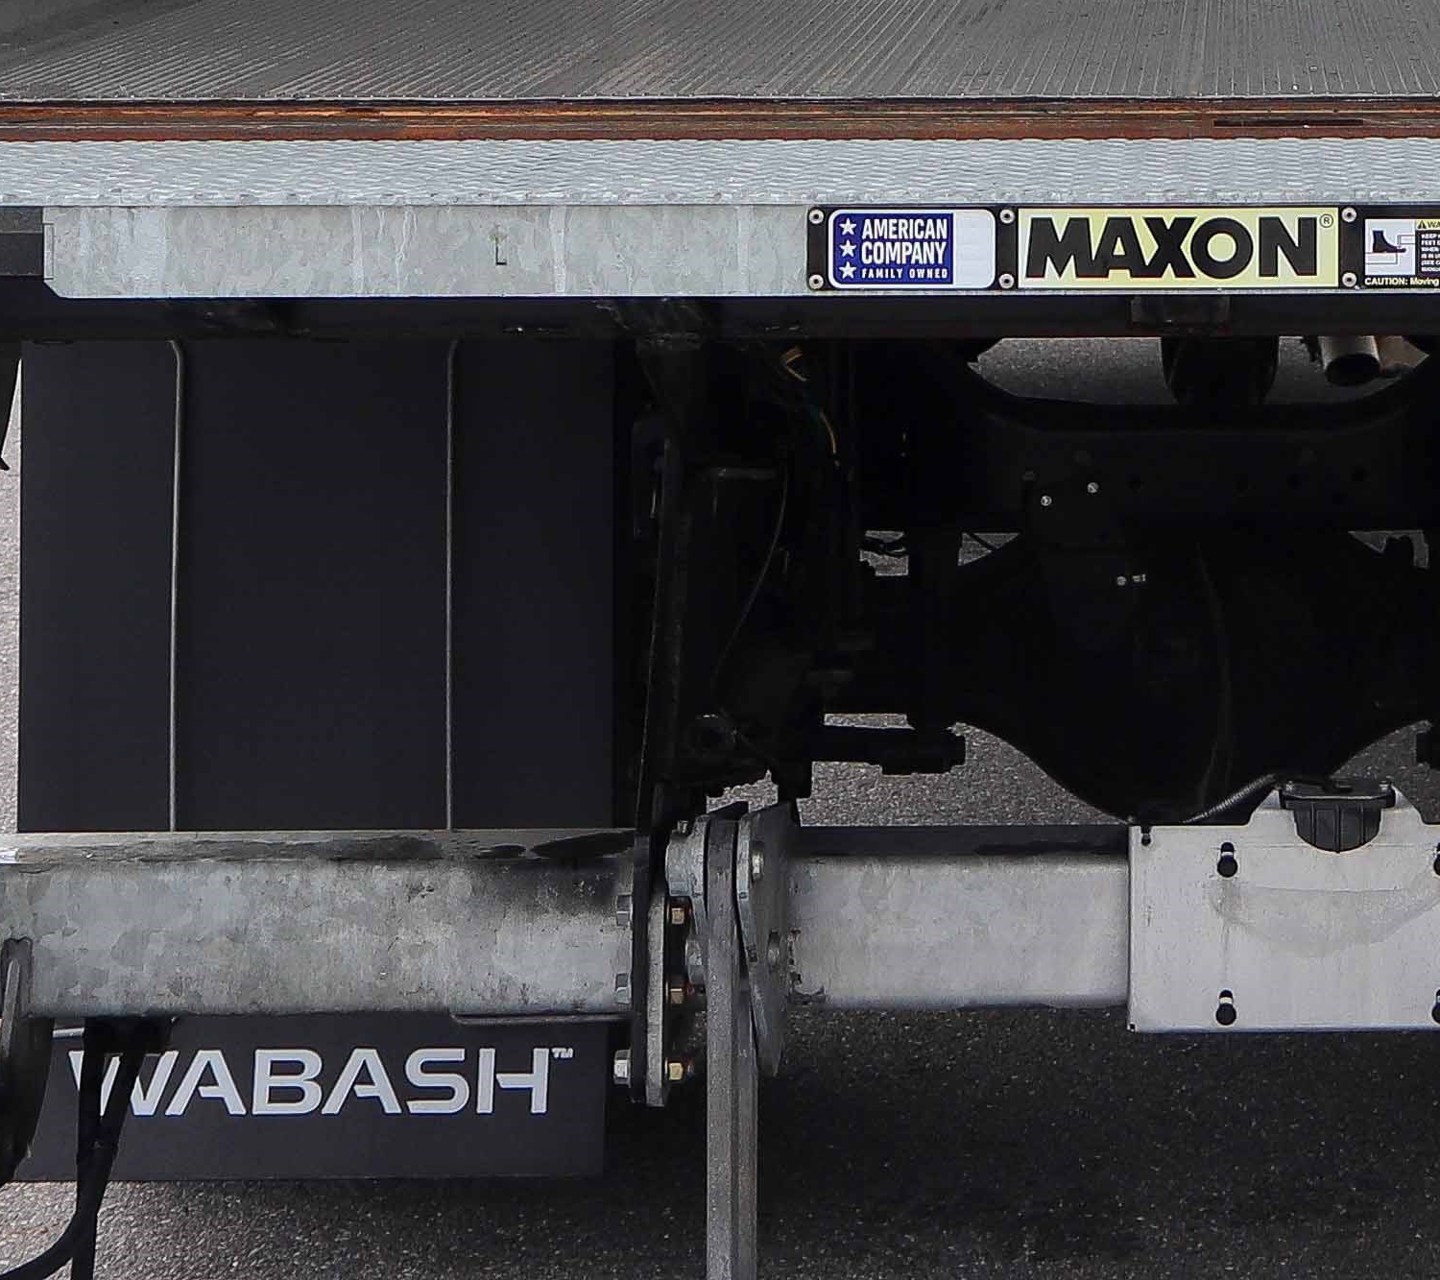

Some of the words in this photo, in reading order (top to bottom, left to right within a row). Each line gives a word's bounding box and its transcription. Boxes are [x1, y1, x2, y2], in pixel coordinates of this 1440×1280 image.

[861, 218, 947, 240] AMERICAN
[861, 241, 947, 265] COMPANY
[1026, 216, 1318, 279] MAXON
[861, 268, 903, 279] FAMILY
[909, 268, 948, 279] OWNED
[1364, 277, 1408, 286] CAUTION:
[1410, 277, 1439, 287] Moving
